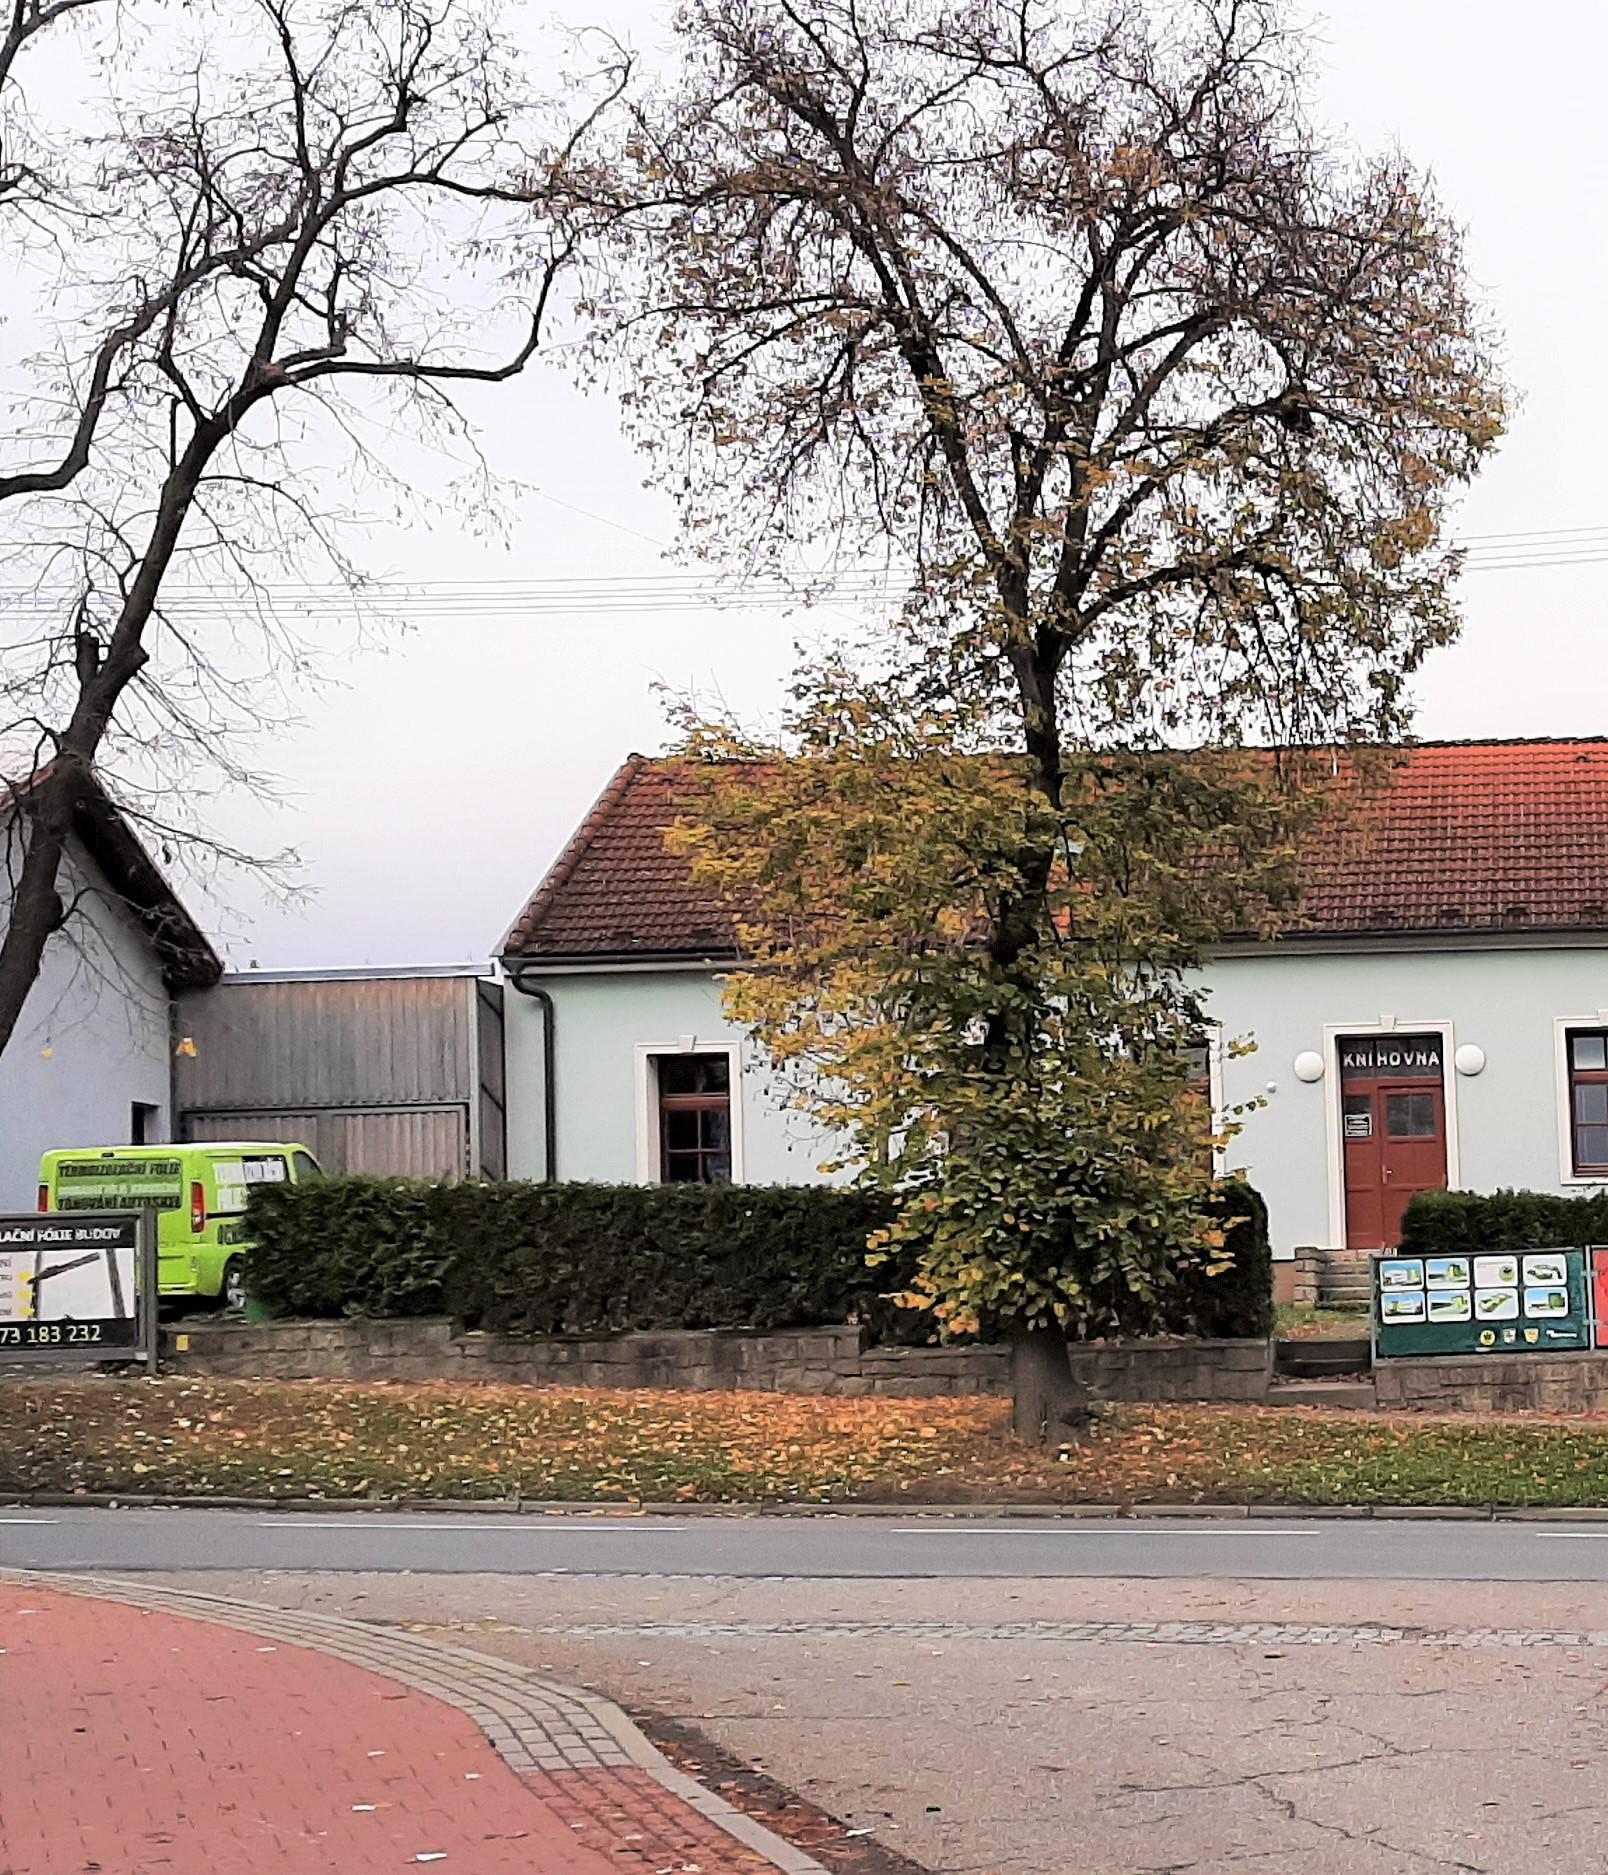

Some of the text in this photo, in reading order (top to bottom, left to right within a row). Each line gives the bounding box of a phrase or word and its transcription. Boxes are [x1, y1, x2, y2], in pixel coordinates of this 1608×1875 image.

[1343, 1050, 1440, 1067] KNIHOVNA
[0, 1324, 101, 1344] 73 183 232
